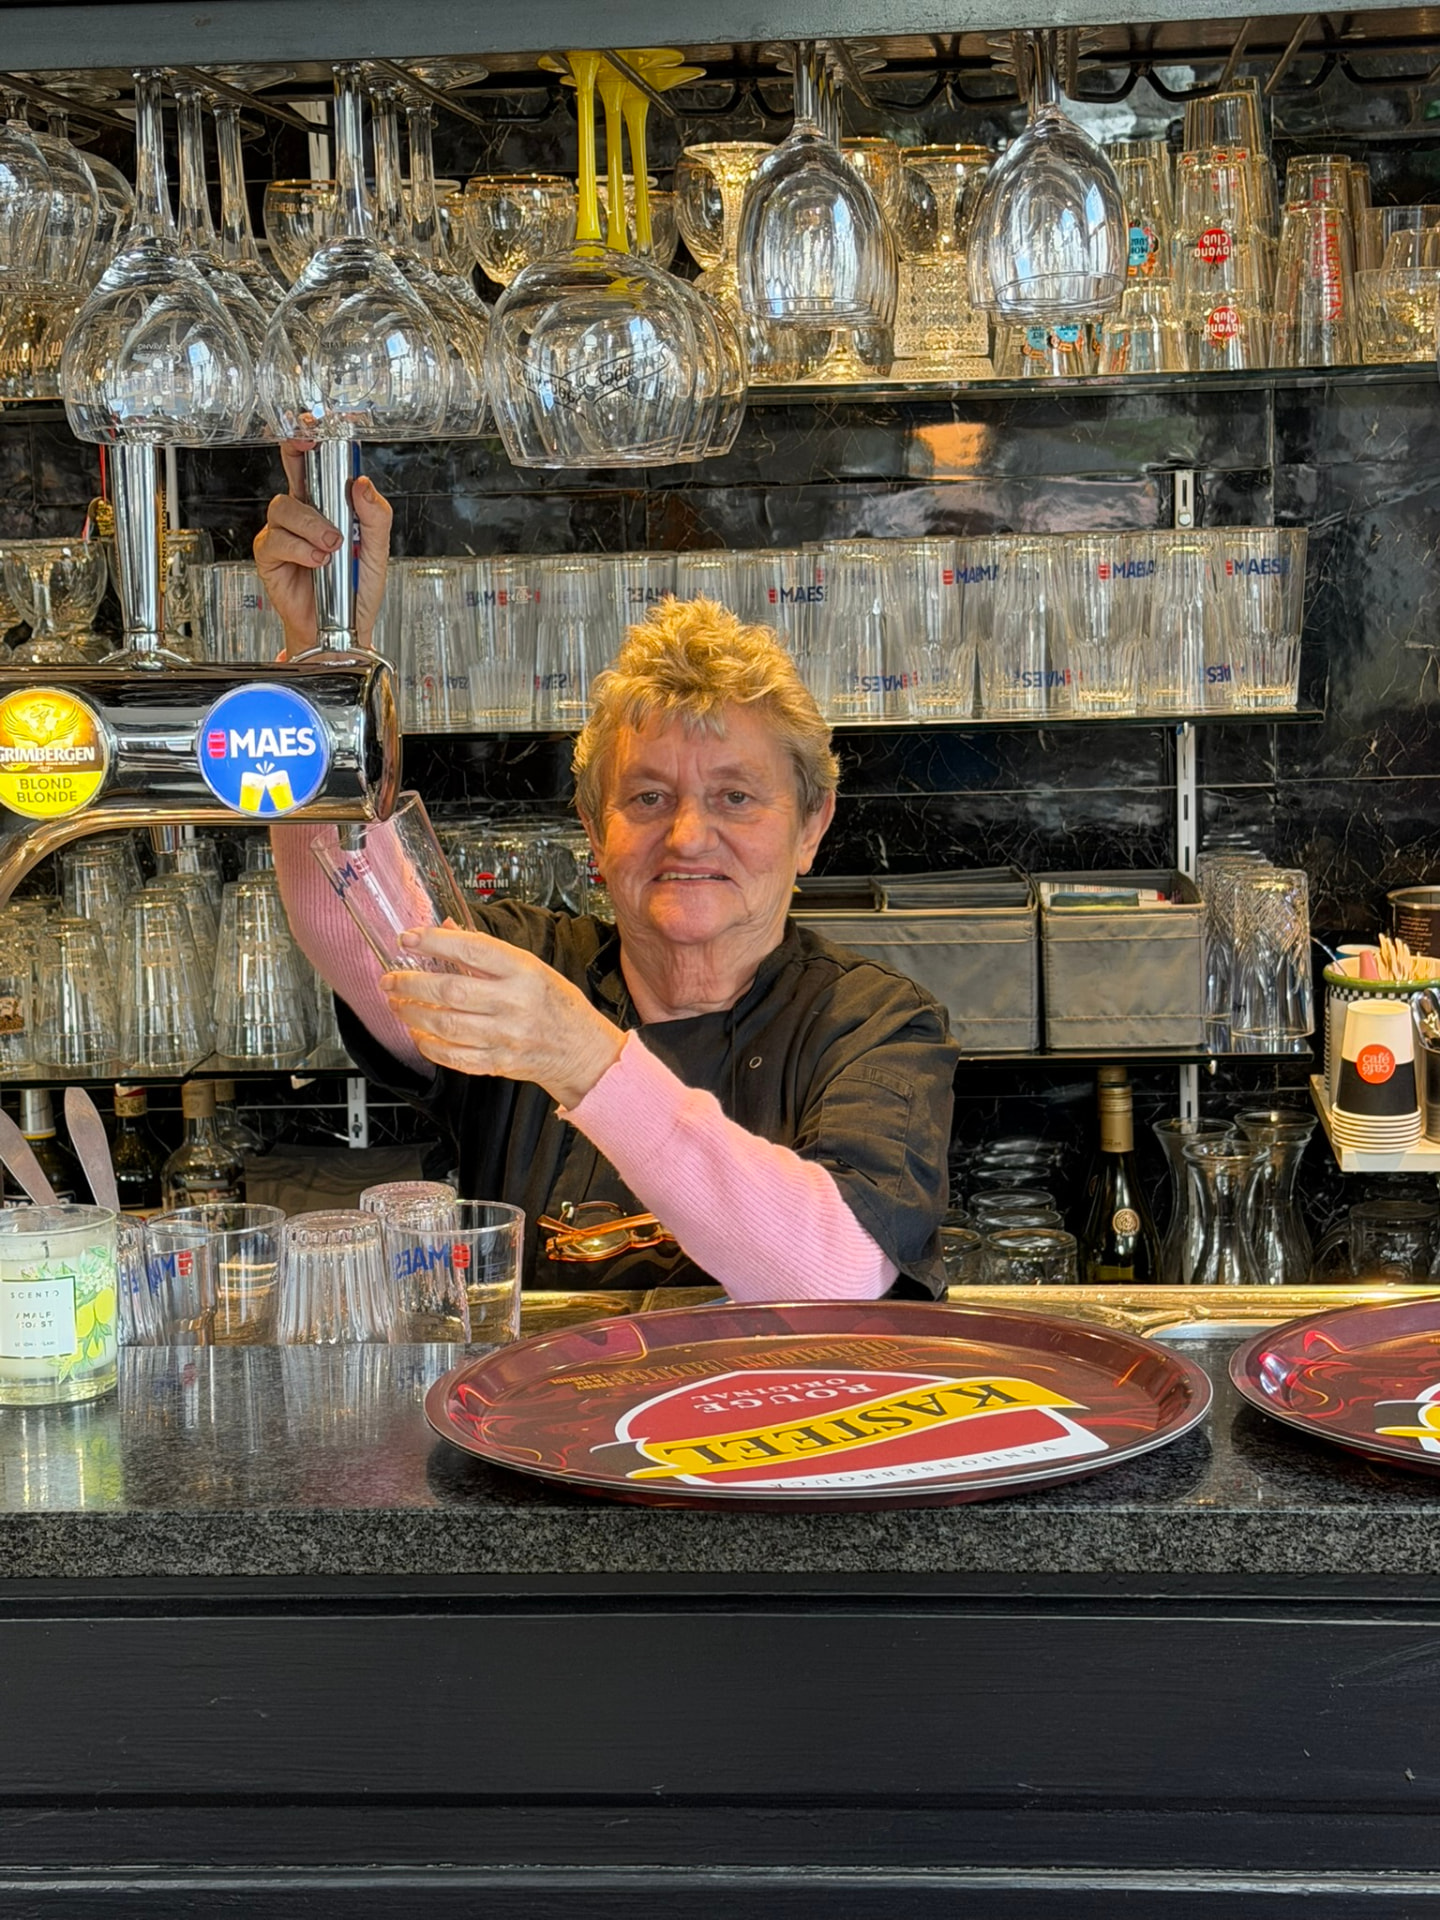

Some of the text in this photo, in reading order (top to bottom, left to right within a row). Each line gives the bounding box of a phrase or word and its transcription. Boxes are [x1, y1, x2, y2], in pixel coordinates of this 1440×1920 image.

[1203, 233, 1229, 248] Club
[1194, 245, 1237, 258] Havana
[1324, 221, 1344, 321] LAGUNITAS
[1213, 310, 1237, 323] Club
[1204, 321, 1245, 334] Havana
[1234, 558, 1281, 576] MAES
[780, 586, 824, 603] MAES
[861, 674, 904, 692] MAES
[1023, 670, 1067, 688] MAES
[229, 727, 316, 758] MAES
[19, 777, 73, 790] BLOND
[16, 790, 78, 803] BLONDE
[464, 878, 509, 889] MARTINI
[1362, 1052, 1390, 1064] café
[1362, 1064, 1390, 1076] café
[690, 1378, 848, 1401] ORIGINAL
[693, 1383, 878, 1414] ROUGE
[662, 1383, 1032, 1467] KASTEEL
